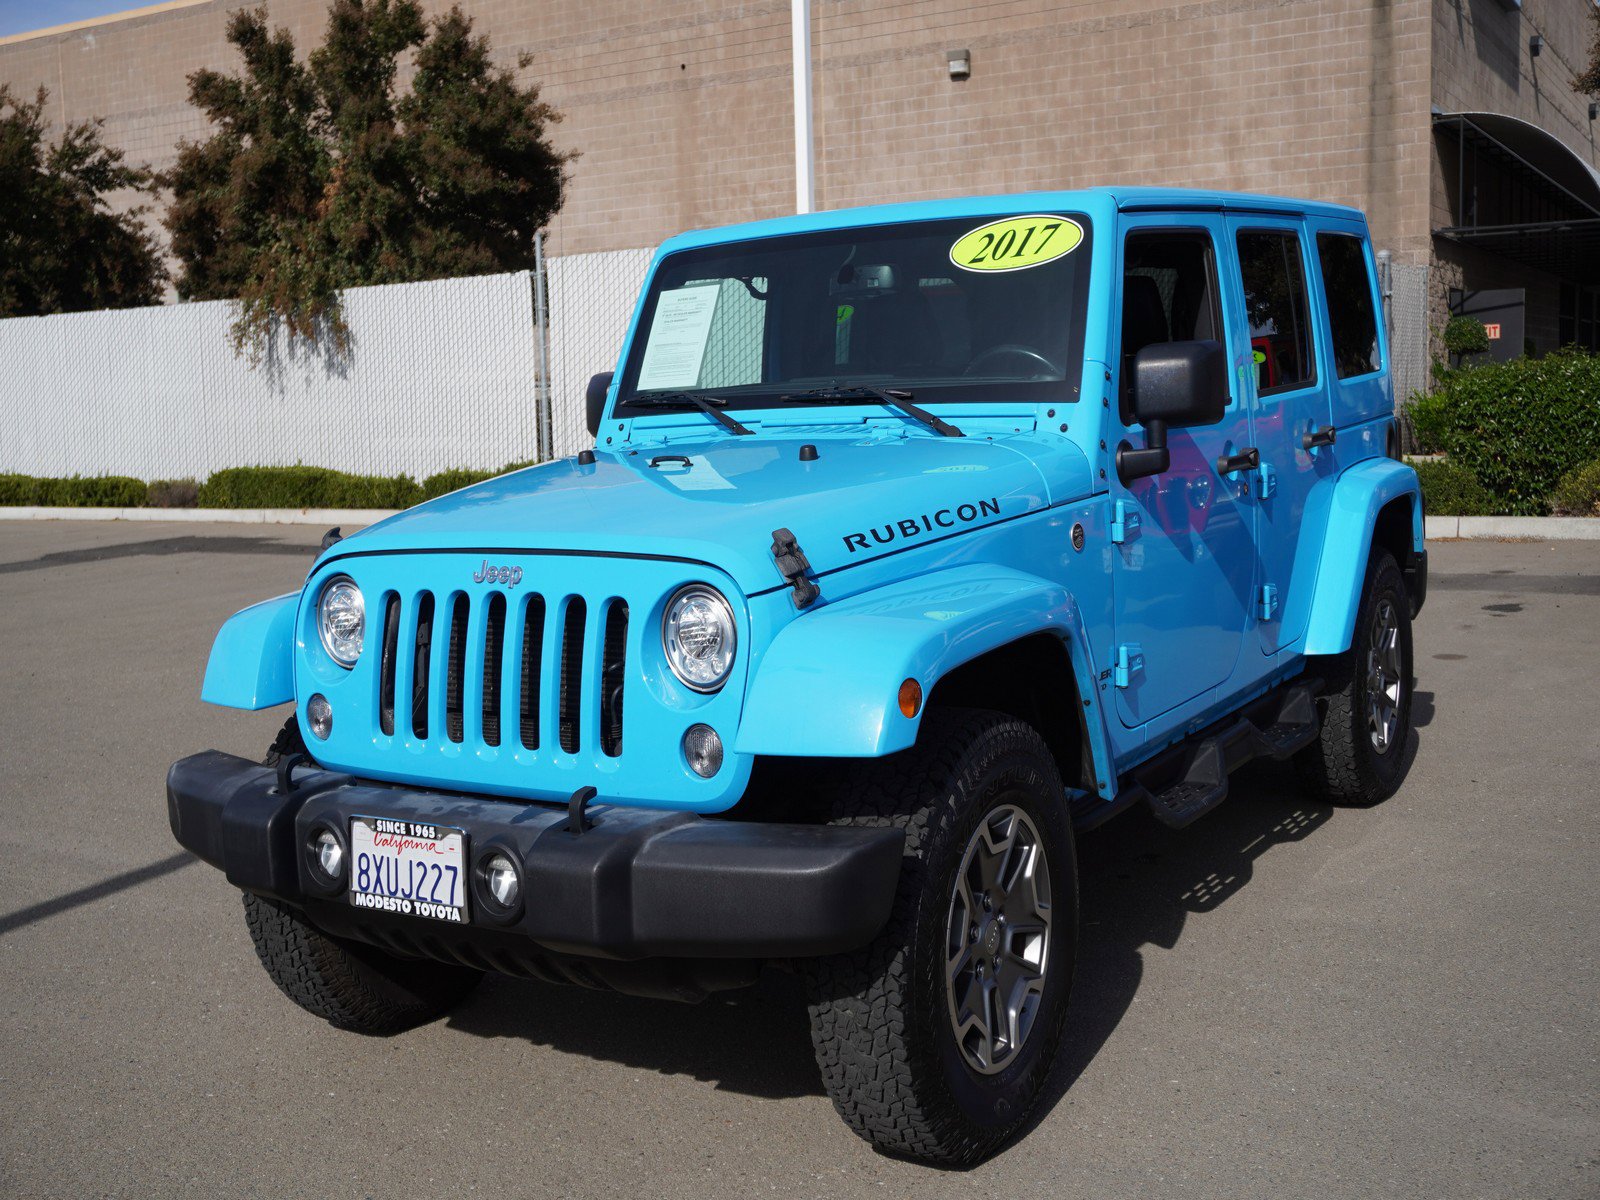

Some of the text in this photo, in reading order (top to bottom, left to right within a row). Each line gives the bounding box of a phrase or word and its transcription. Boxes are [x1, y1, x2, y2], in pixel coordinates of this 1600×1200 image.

[968, 223, 1063, 264] 2017
[842, 497, 1001, 553] RUBICON
[473, 559, 523, 589] Jeep
[373, 832, 444, 855] California
[376, 820, 435, 839] SINCE 1965
[357, 852, 458, 905] 8XUJ227
[355, 892, 461, 921] MODESTO TOYOTA
